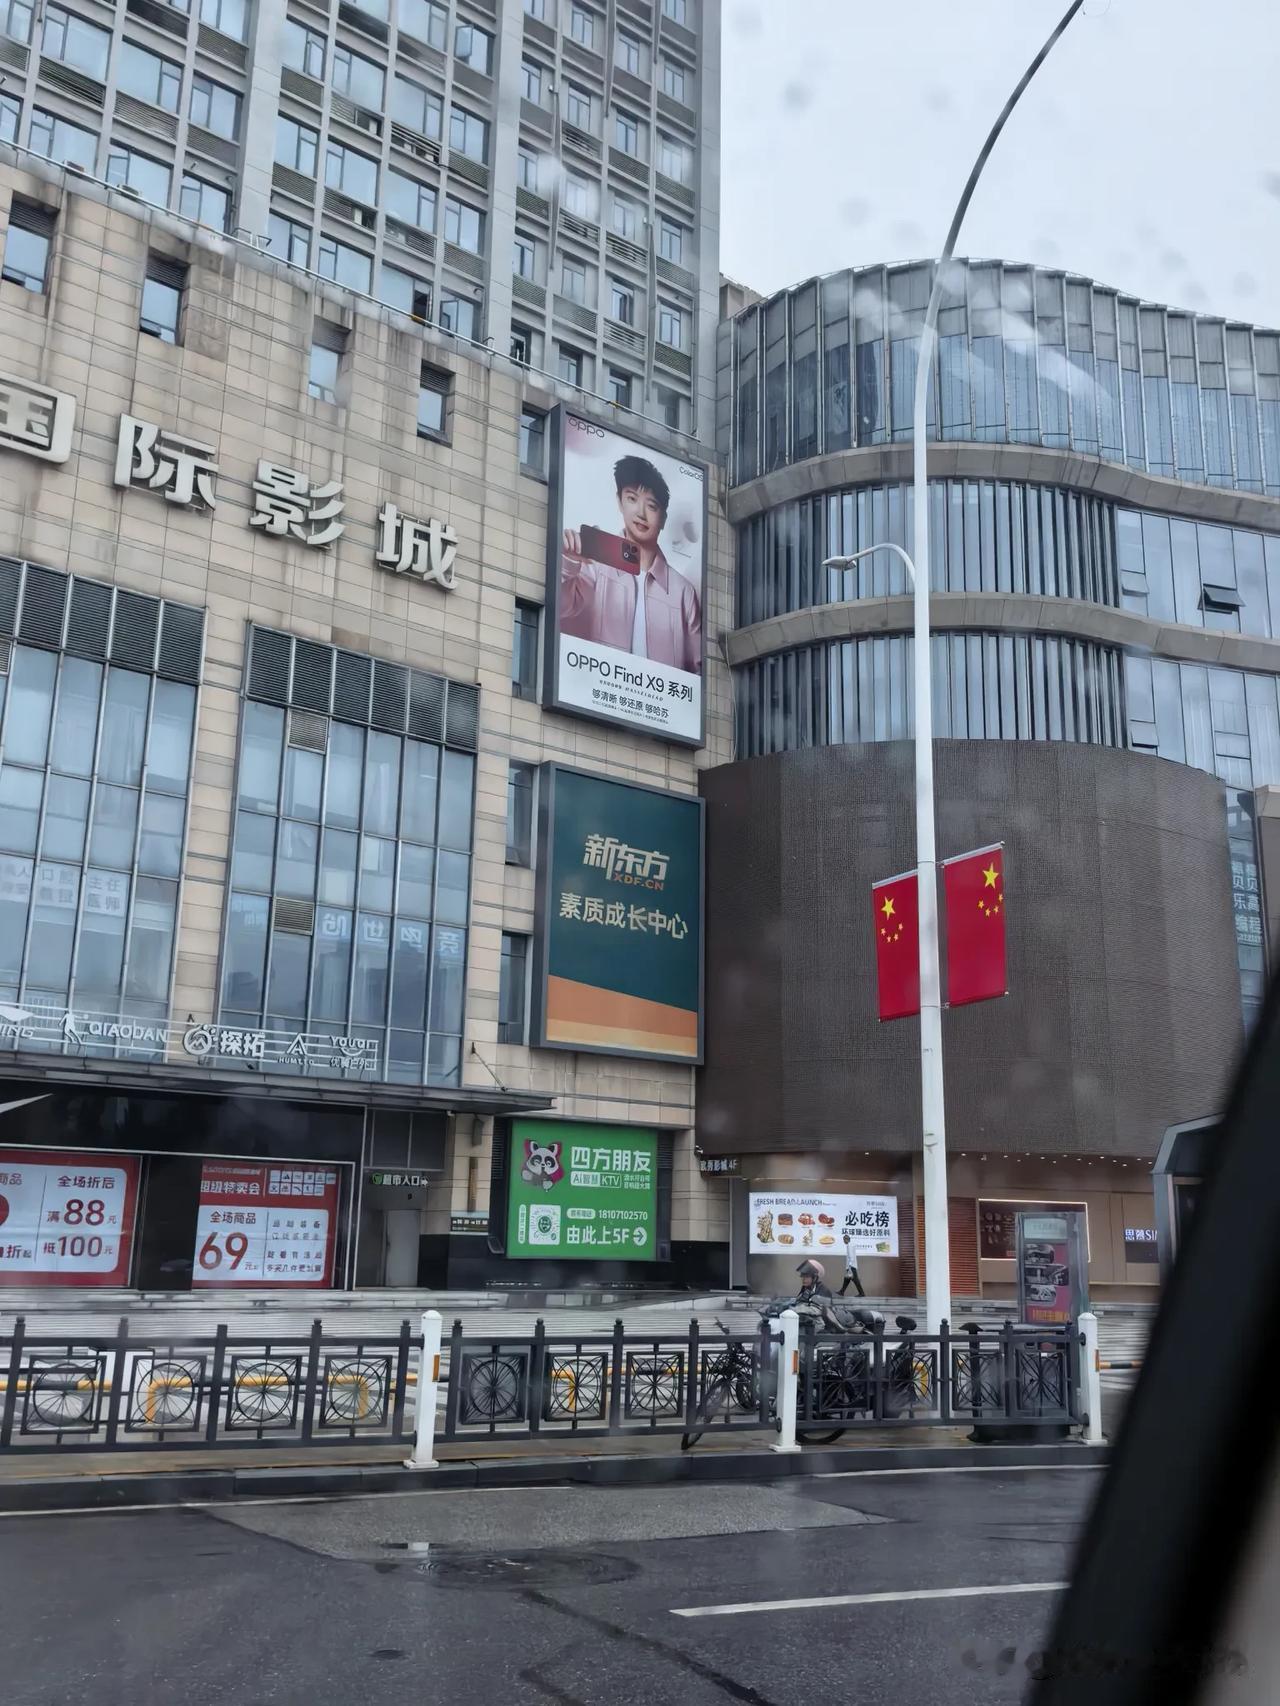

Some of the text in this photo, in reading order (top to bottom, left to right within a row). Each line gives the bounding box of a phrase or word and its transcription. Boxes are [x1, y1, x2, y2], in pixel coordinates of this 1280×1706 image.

[567, 651, 611, 677] OPPO
[614, 664, 643, 687] Find
[645, 674, 665, 693] X9
[667, 680, 693, 703] 系列
[592, 688, 618, 704] 够清晰
[619, 696, 644, 711] 够还原
[645, 702, 669, 719] 够哈苏
[583, 833, 669, 880] 新东方
[612, 872, 664, 891] XDF.CN
[559, 891, 689, 940] 素质成长中心
[89, 1022, 167, 1042] QIAODAN
[221, 1031, 265, 1058] 探拓
[571, 1146, 651, 1173] 四方朋友
[58, 1175, 116, 1189] 全场折后
[383, 1174, 419, 1186] 超市入口
[601, 1175, 620, 1186] KTV
[210, 1210, 257, 1225] 全场商品
[845, 1210, 890, 1228] 必吃榜
[566, 1224, 630, 1245] 由此上5F
